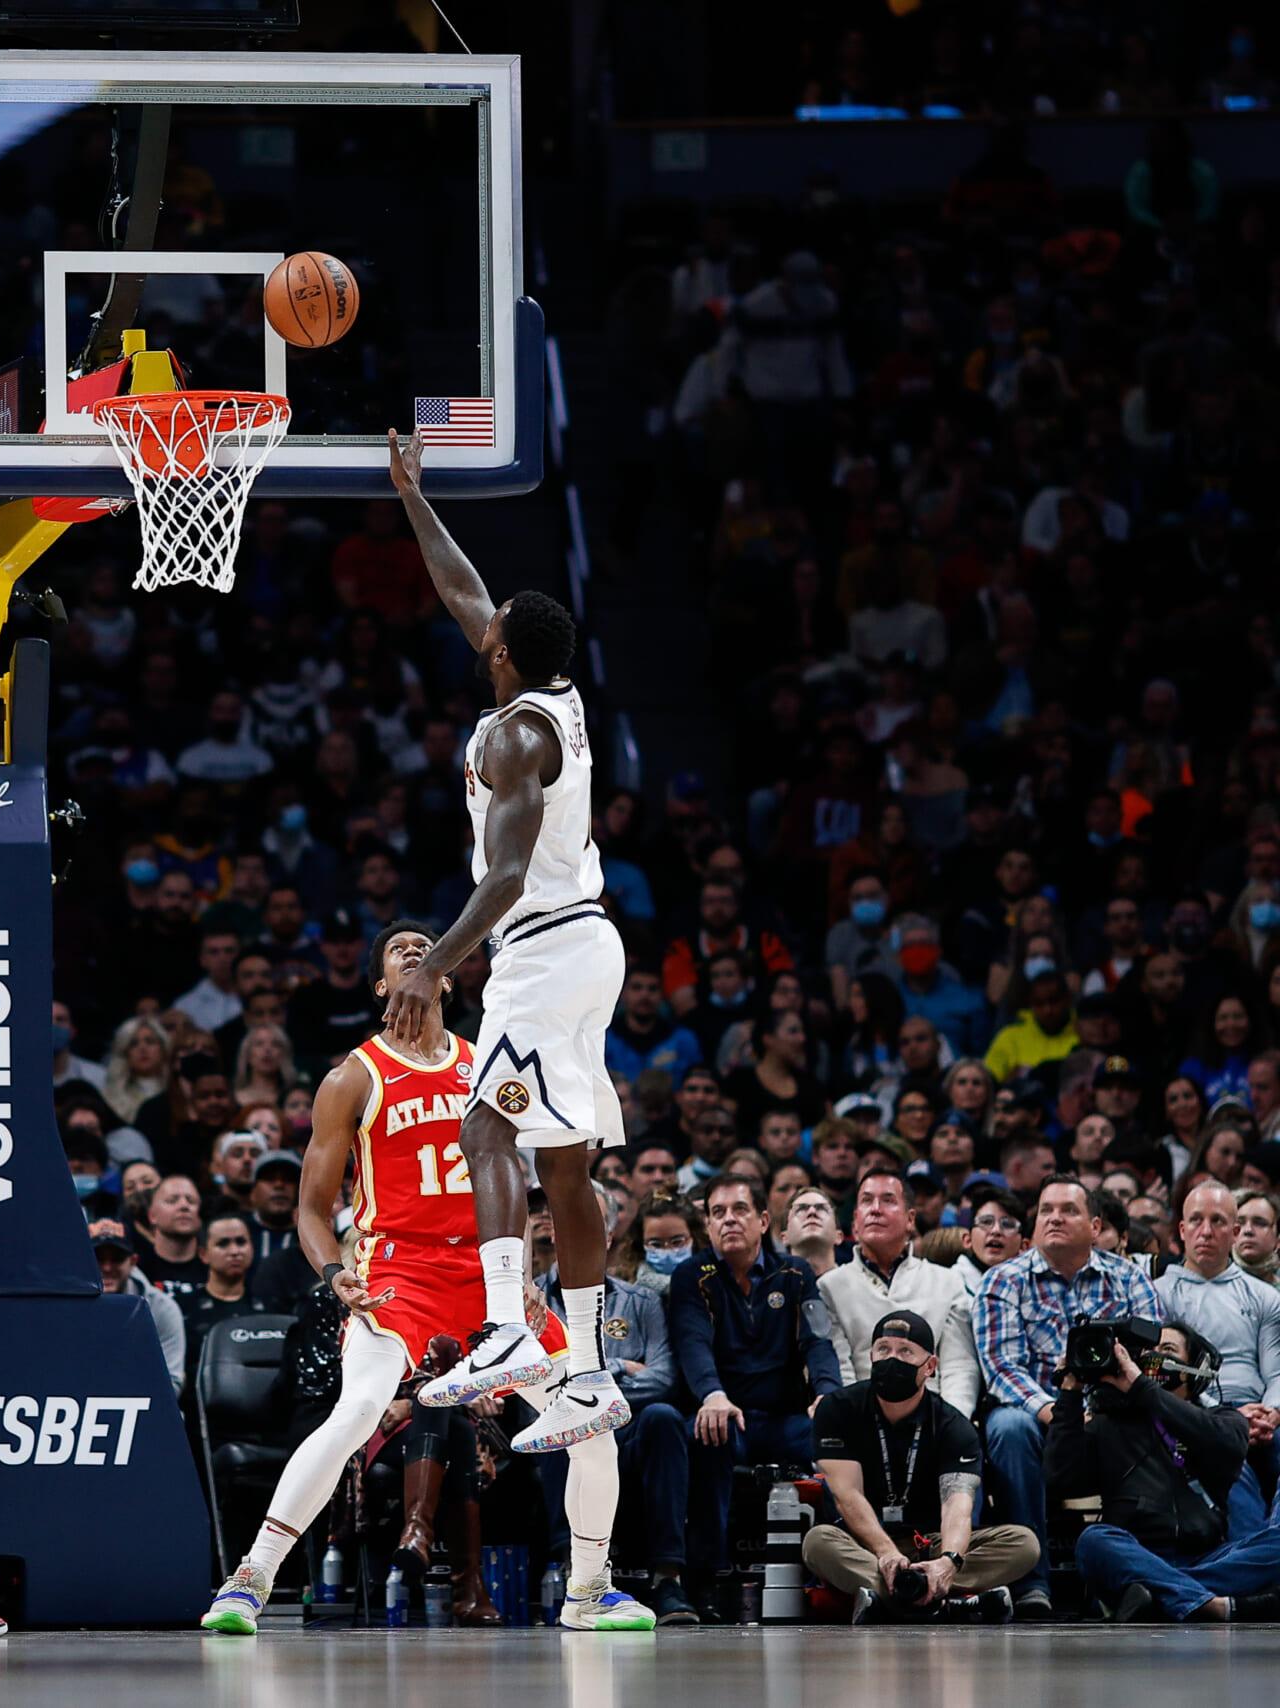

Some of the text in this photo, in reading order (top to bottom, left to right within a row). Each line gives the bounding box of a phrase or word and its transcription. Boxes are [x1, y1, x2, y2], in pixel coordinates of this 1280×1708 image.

[323, 259, 348, 319] Wilson
[386, 1093, 471, 1137] ATLAN
[416, 1142, 474, 1196] 12
